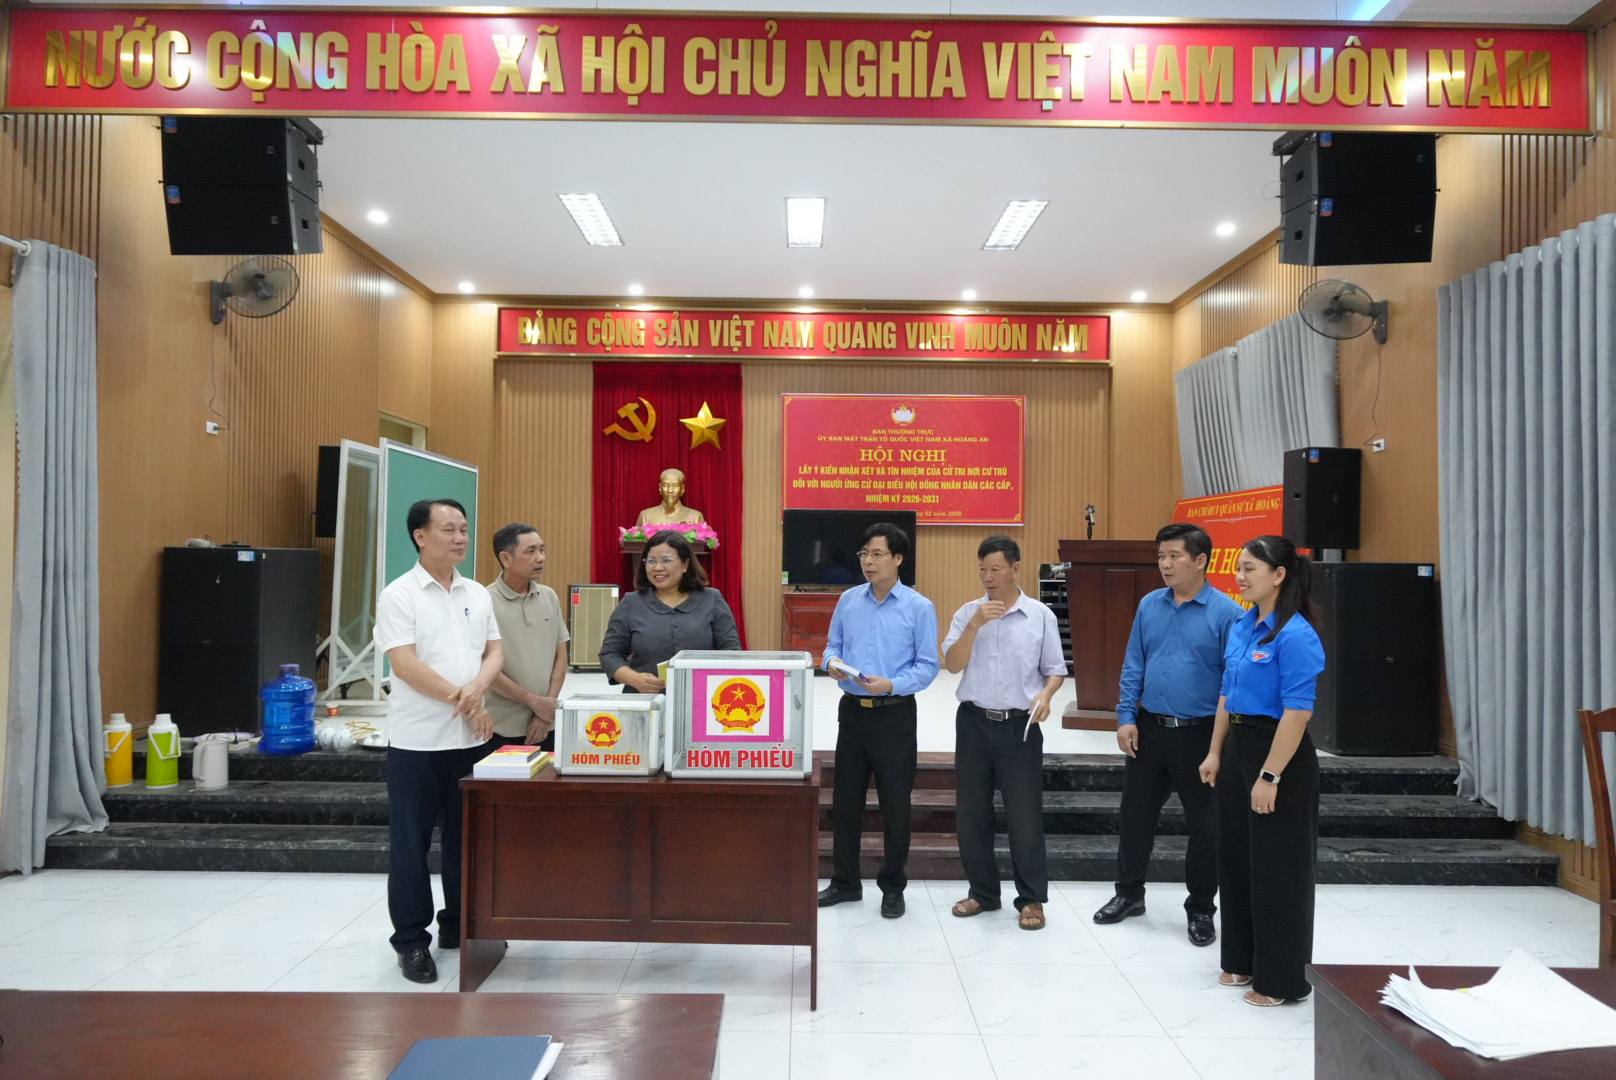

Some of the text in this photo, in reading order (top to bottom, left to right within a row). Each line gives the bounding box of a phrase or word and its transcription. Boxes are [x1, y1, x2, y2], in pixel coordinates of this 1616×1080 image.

[44, 16, 1552, 111] NƯỚC CỘNG HÒA XÃ HỘI CHỦ NGHĨA VIỆT NAM MUÔN NĂM
[518, 309, 1089, 353] ĐẢNG CỘNG SẢN VIỆT NAM QUANG VINH MUÔN NĂM
[859, 445, 947, 466] HỘI NGHỊ
[798, 463, 813, 475] LẤY
[820, 464, 837, 475] KIẾN
[839, 465, 859, 477] NHẬN
[876, 465, 886, 476] VÀ
[901, 466, 925, 477] NHIỆM
[926, 465, 941, 476] CỦA
[954, 467, 965, 476] TRI
[793, 477, 805, 488] ĐỐI
[905, 479, 917, 490] HỘI
[919, 479, 939, 490] ĐỒNG
[941, 480, 961, 490] NHÂN
[963, 480, 978, 490] DÂN
[979, 480, 995, 490] CÁC
[865, 493, 889, 504] NHIỆM
[902, 495, 939, 503] 2026-2031
[1255, 496, 1281, 511] HOÀNG
[571, 751, 640, 766] HÒM PHIẾU
[686, 743, 794, 769] HÒM PHIẾU
